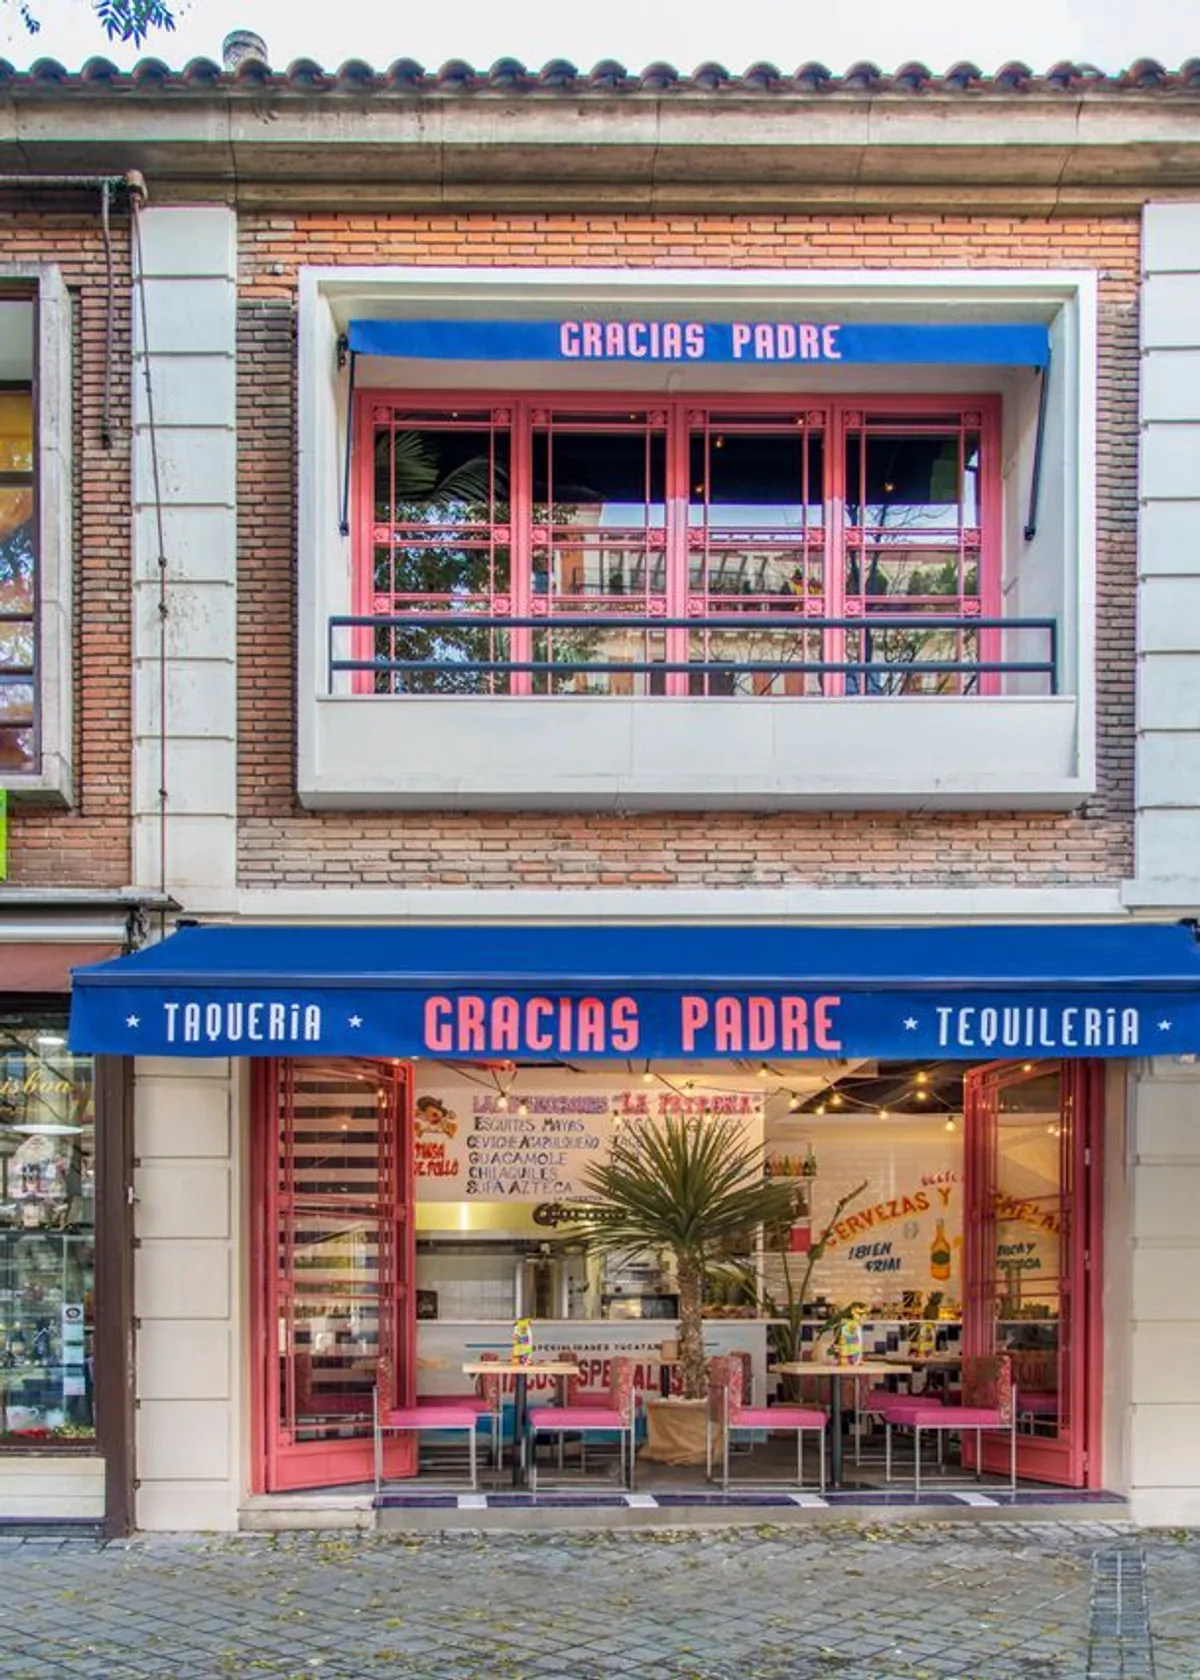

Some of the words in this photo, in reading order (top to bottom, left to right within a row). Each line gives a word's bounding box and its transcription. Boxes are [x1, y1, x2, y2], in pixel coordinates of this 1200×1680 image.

[560, 321, 705, 358] GRACIAS
[732, 323, 842, 359] PADRE
[423, 996, 640, 1052] GRACIAS
[681, 996, 842, 1052] PADRE
[468, 1152, 568, 1166] GUACAMOLE
[508, 1181, 573, 1194] AZTECA
[937, 1187, 951, 1207] Y
[614, 1340, 661, 1350] YUCATAN
